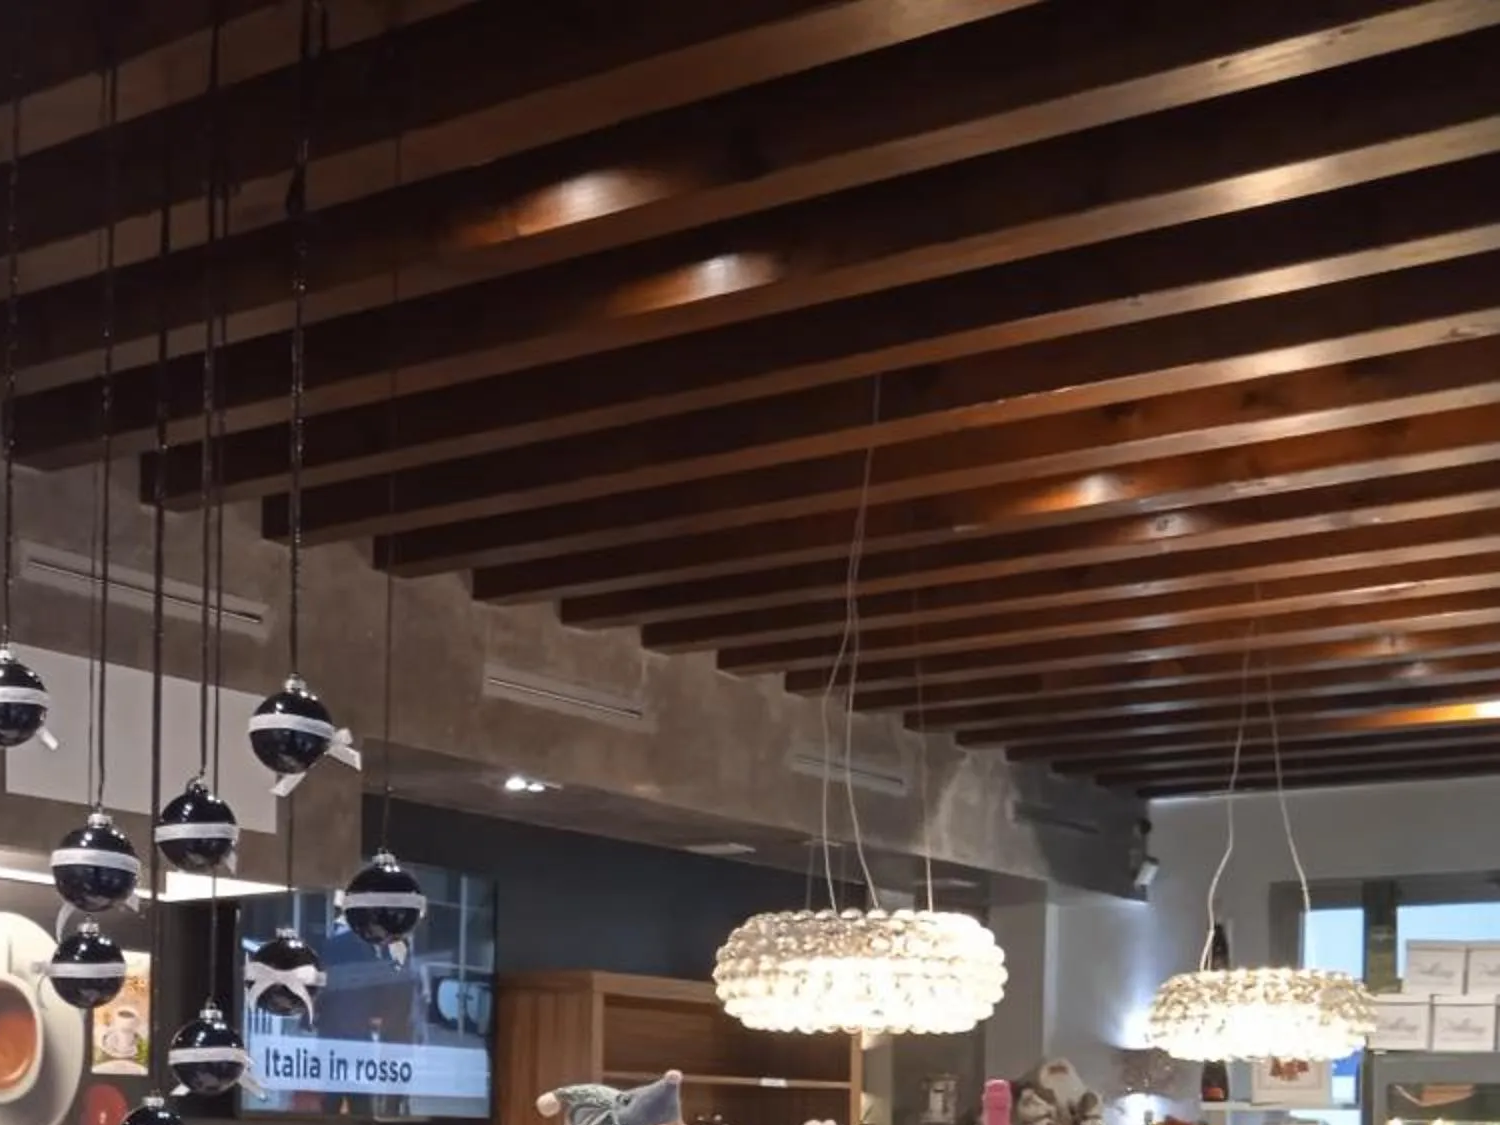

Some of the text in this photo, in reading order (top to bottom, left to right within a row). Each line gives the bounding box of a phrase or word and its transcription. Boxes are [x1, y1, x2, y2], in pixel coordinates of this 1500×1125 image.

[265, 1047, 412, 1083] Italia in rosso
